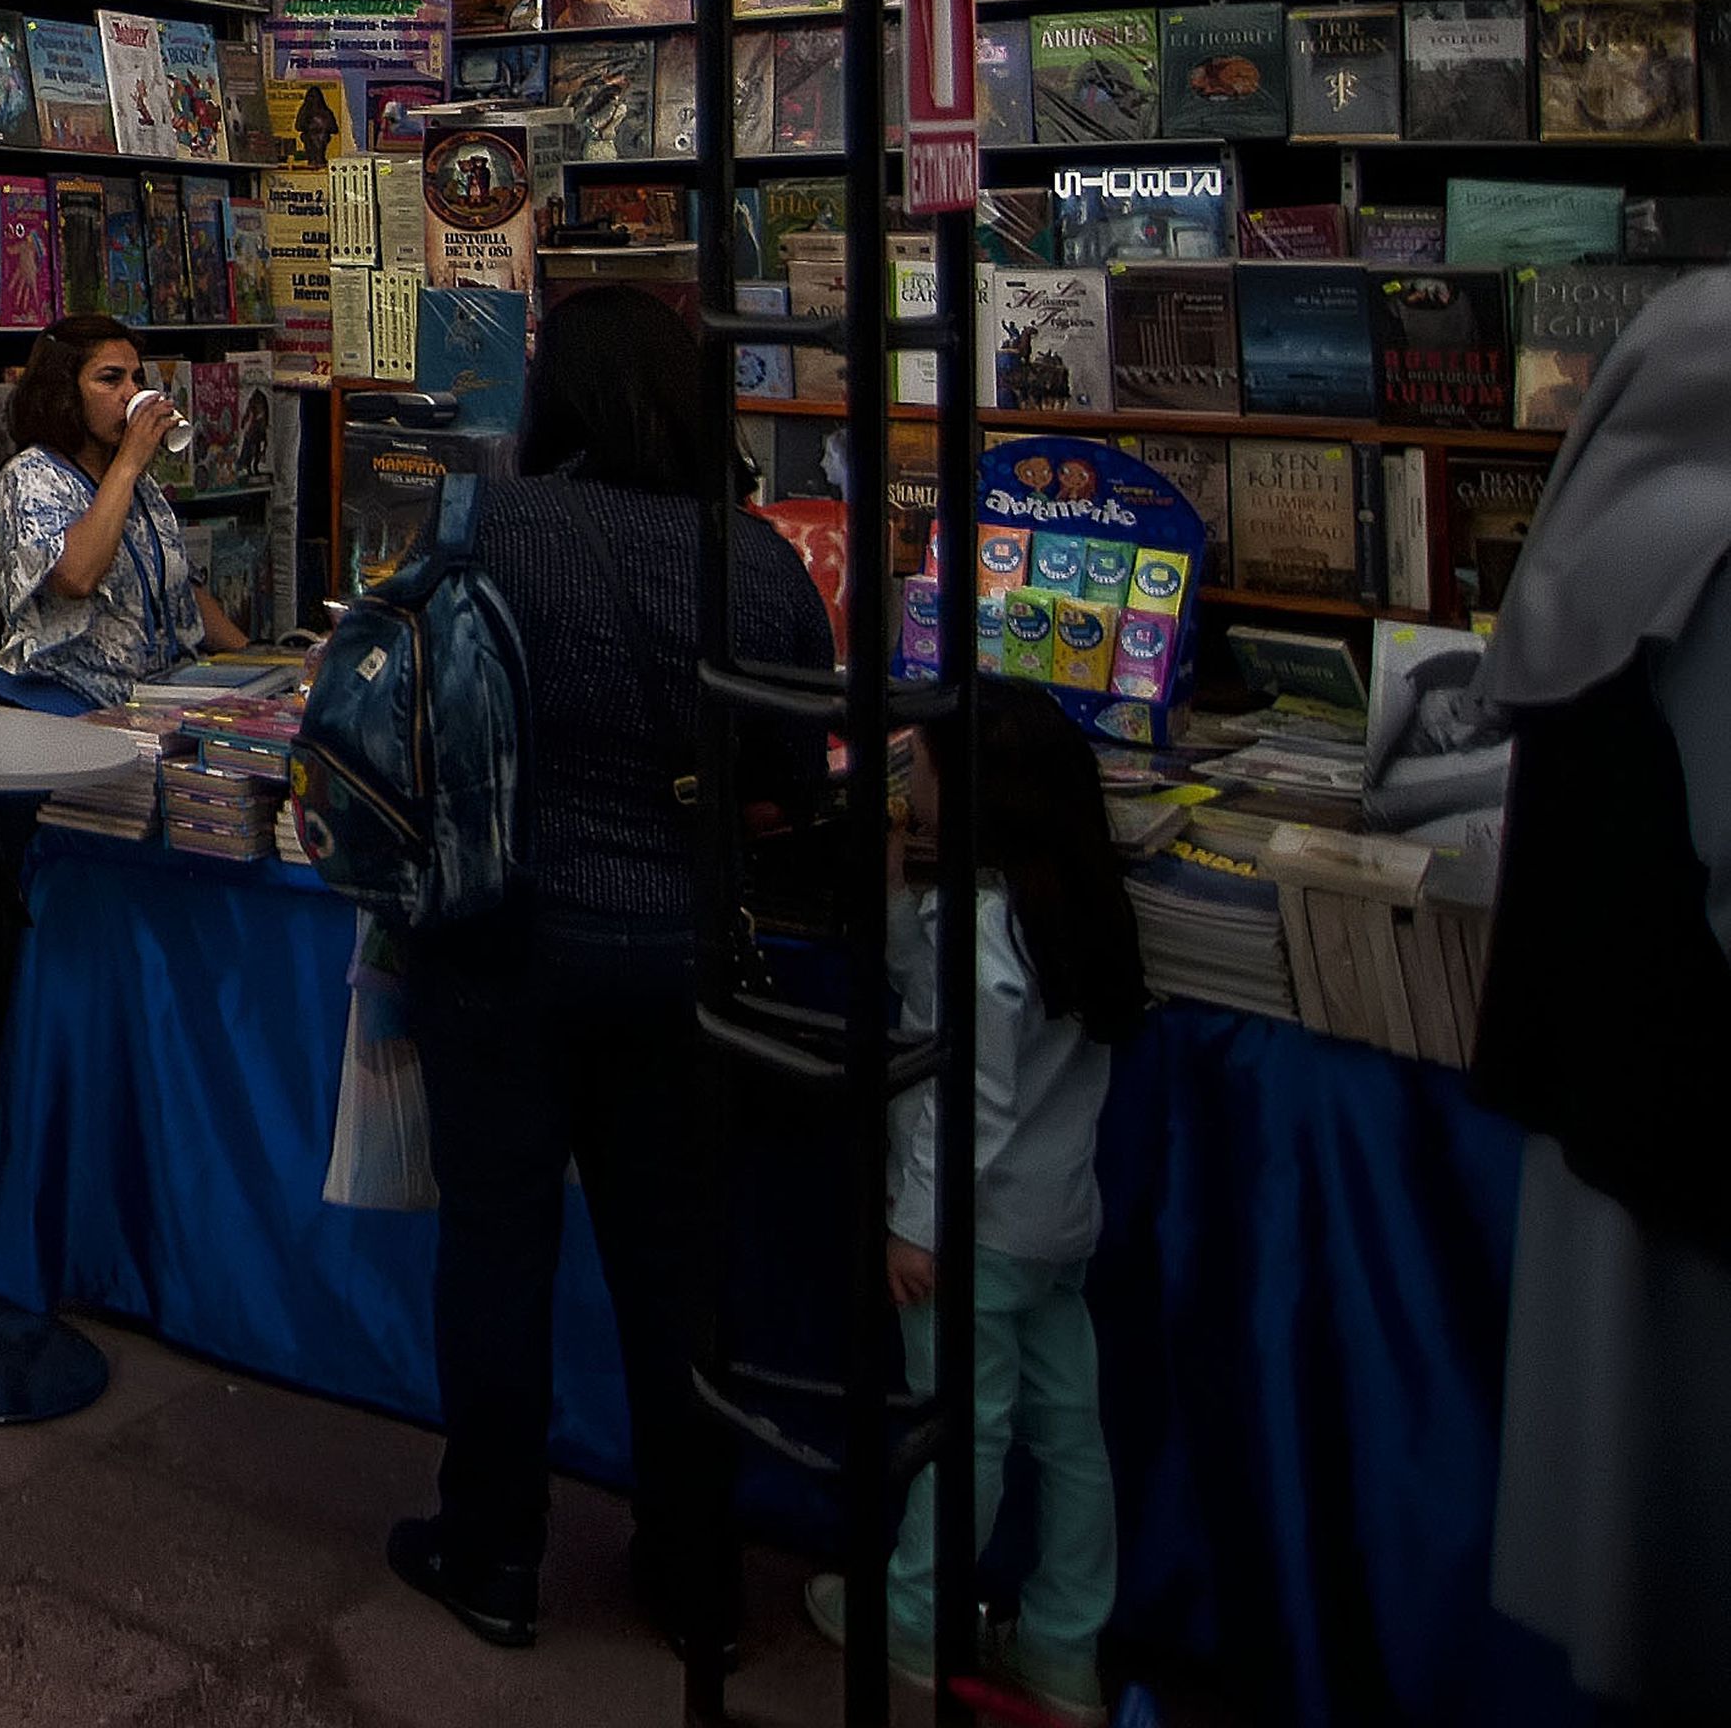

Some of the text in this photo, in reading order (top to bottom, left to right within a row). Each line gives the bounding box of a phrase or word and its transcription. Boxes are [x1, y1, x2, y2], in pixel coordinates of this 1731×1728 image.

[444, 233, 507, 246] HISTORIA
[444, 245, 513, 259] DE UN OSO
[1270, 452, 1319, 472] KEN
[1247, 472, 1341, 492] FOLLETT
